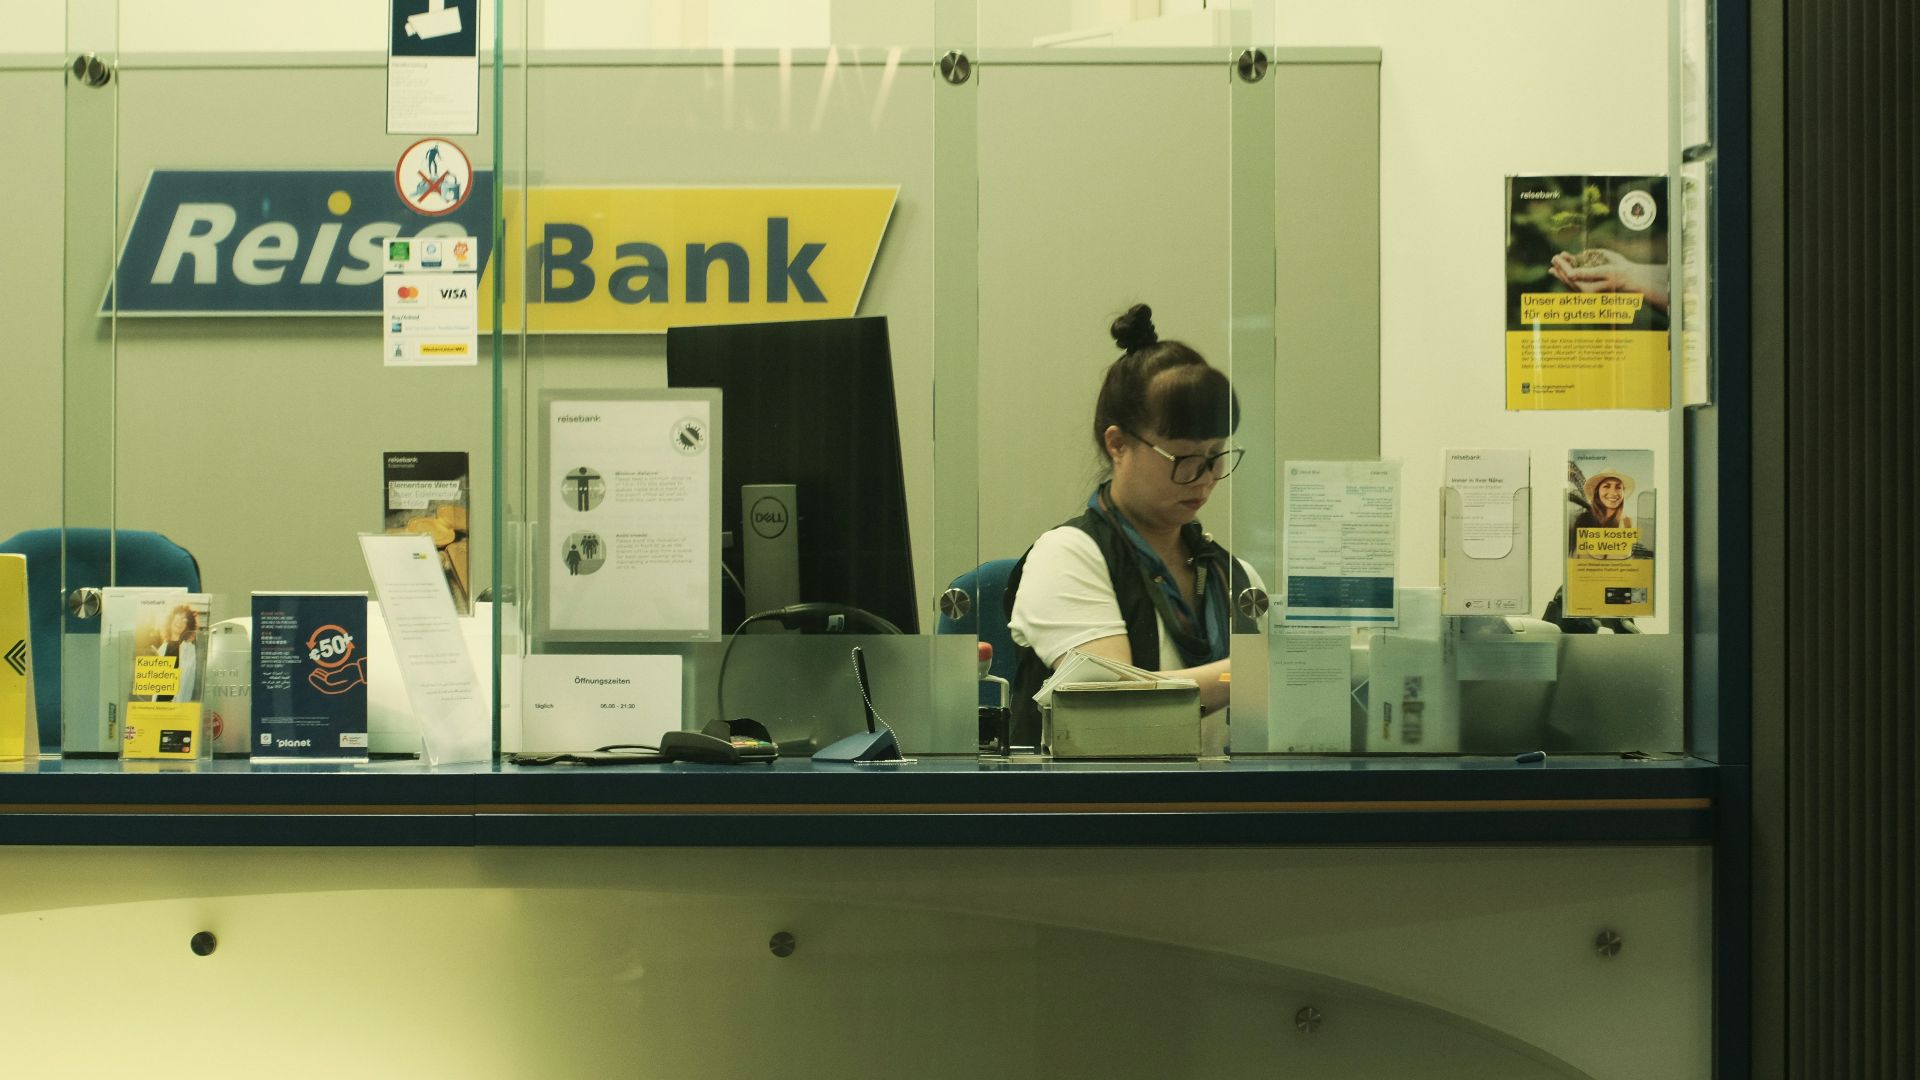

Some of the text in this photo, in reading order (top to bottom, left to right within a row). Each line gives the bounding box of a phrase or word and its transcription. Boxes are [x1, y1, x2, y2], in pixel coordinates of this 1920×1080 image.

[151, 191, 828, 304] Reis Bank
[440, 289, 467, 299] VISA
[1524, 296, 1640, 307] Unser aktiver Beitrag
[1524, 310, 1631, 321] für ein gutes Klima.
[557, 415, 600, 423] reisebank
[756, 513, 784, 523] DELL
[1579, 530, 1638, 539] Was kostet
[1579, 542, 1627, 551] die Welt?
[309, 633, 353, 661] €50+
[137, 658, 171, 668] Kaufen,
[136, 670, 178, 680] aufladen,
[575, 676, 630, 686] Öffnungszeiten
[135, 683, 175, 693] loslegen!
[277, 738, 312, 749] planet
